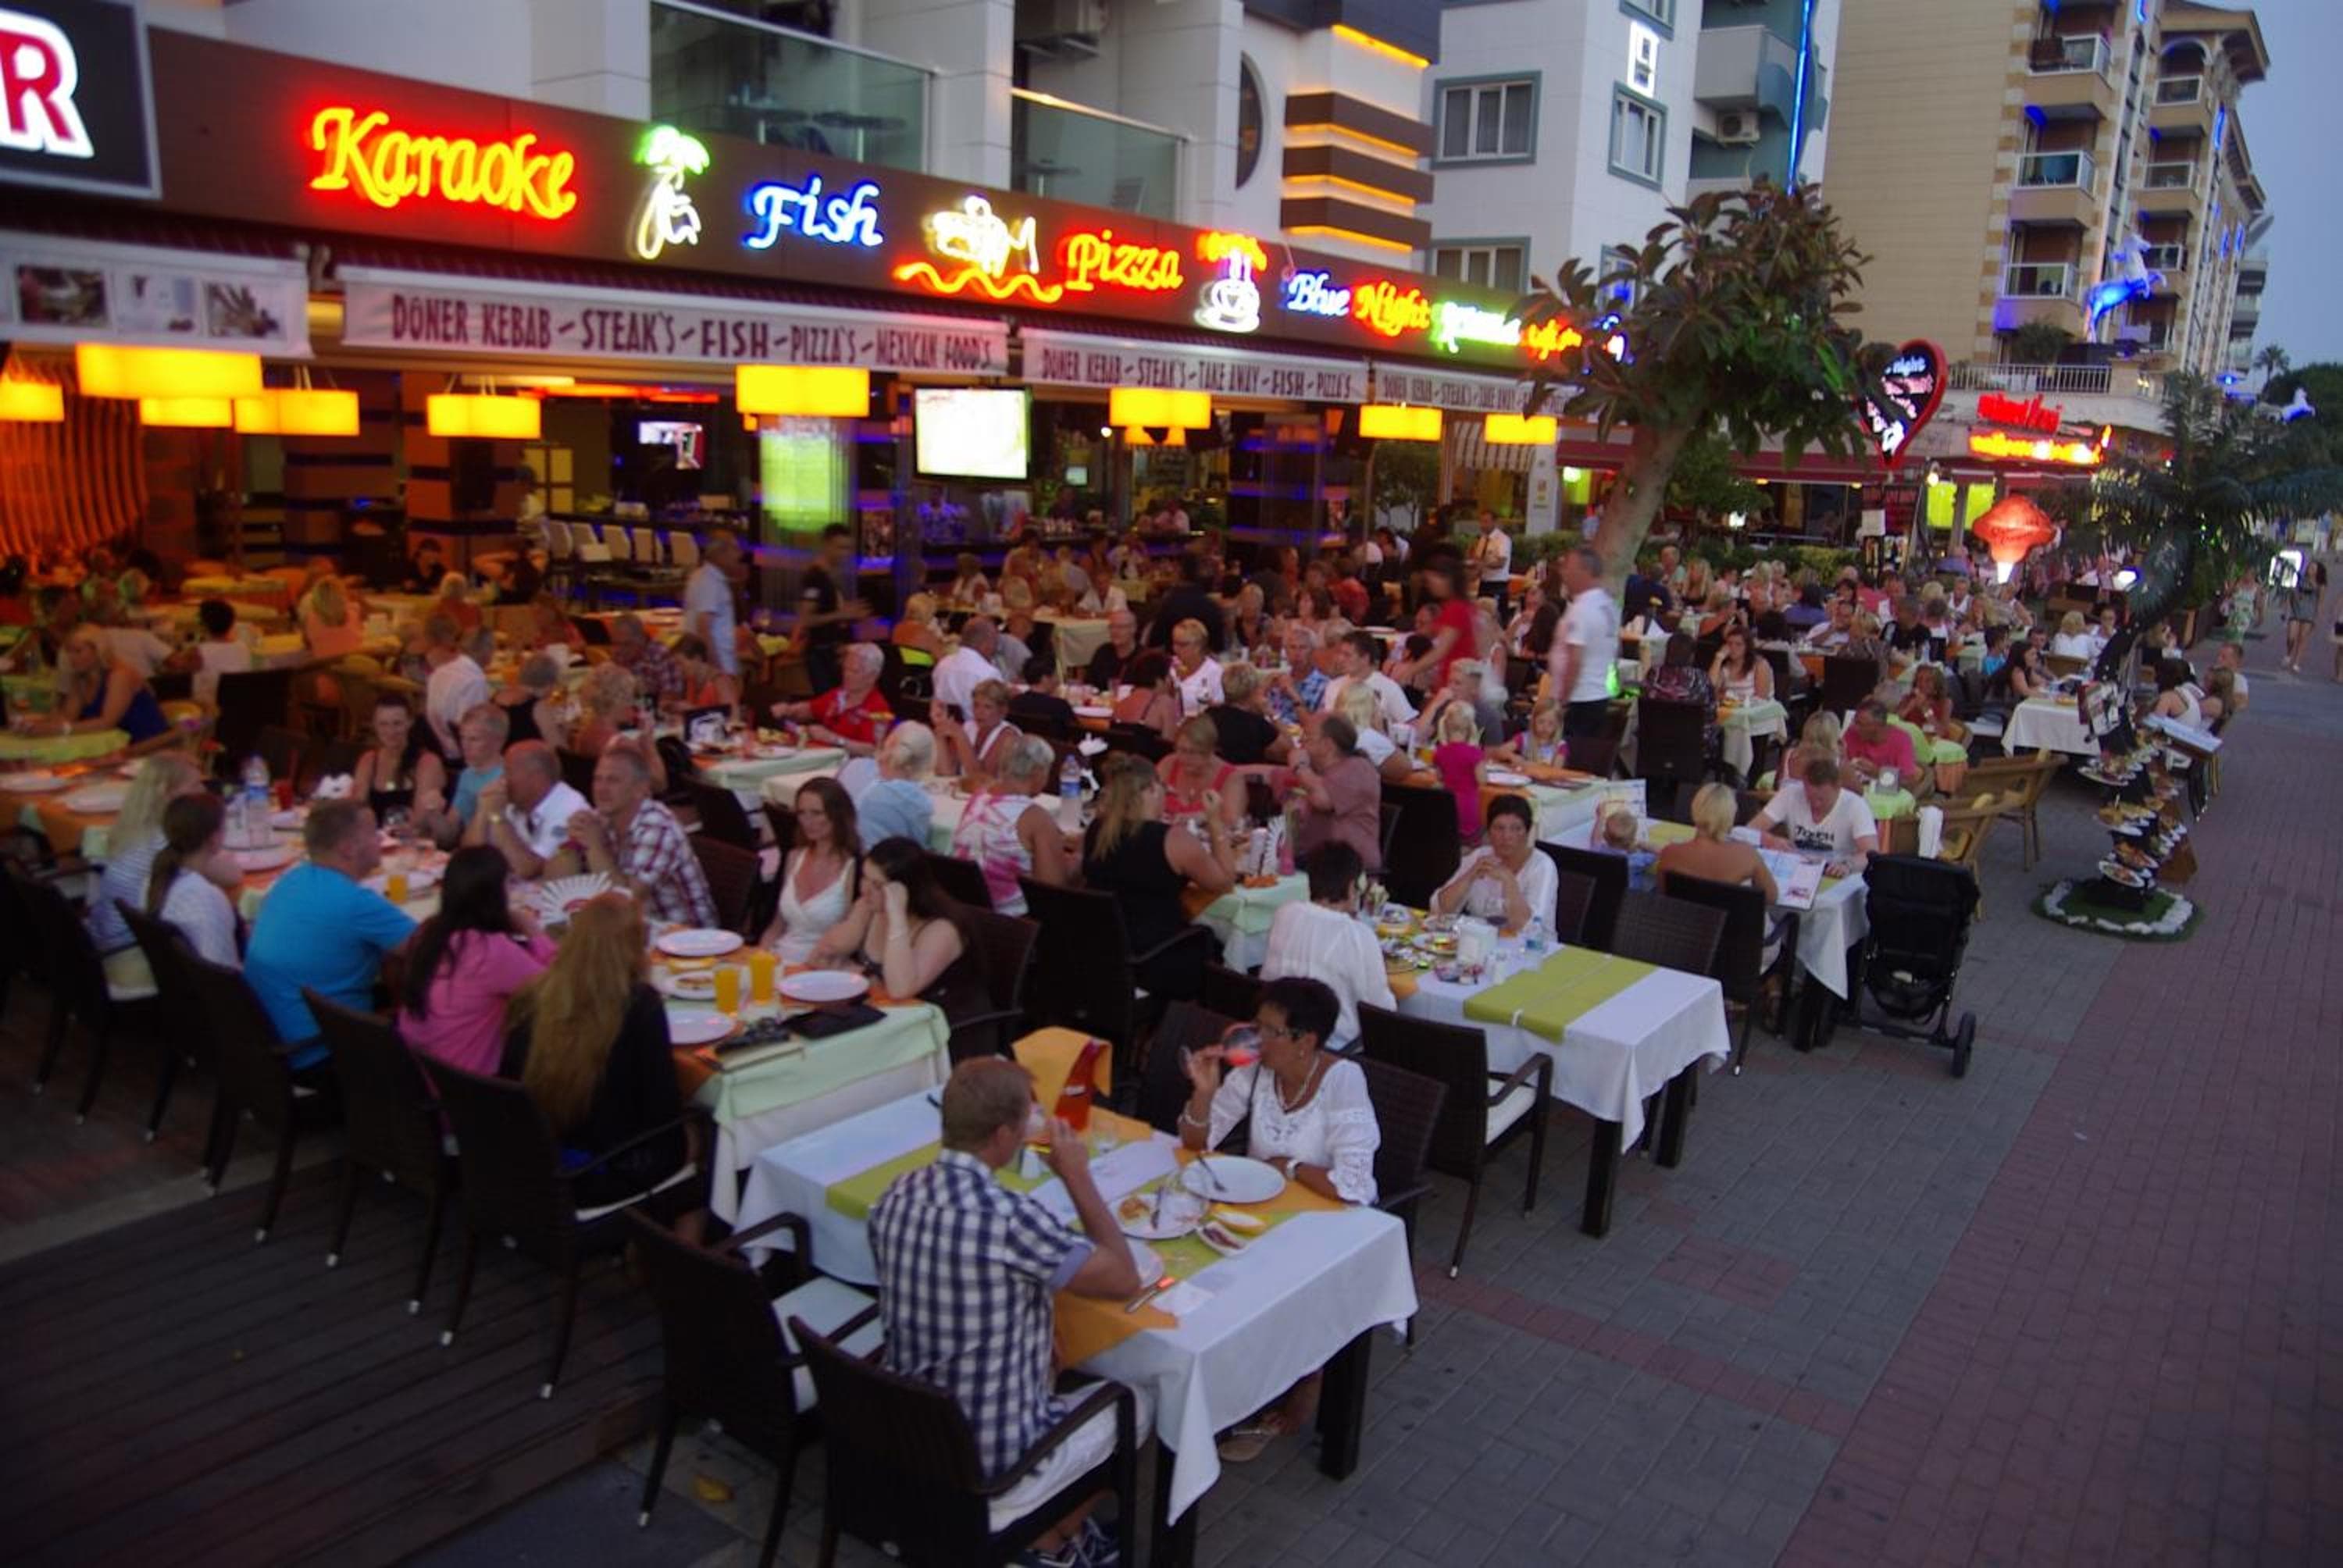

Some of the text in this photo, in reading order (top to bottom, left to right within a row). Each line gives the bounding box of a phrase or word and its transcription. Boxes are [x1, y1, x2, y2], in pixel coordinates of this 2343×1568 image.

[311, 107, 576, 219] Karaoke
[747, 175, 883, 249] Fish
[1067, 230, 1184, 291] Pizza
[482, 302, 551, 349] KEBAB
[701, 319, 769, 359] FISH
[876, 329, 936, 368] MEXICAN
[1288, 270, 1350, 316] Blue
[1355, 280, 1431, 337] Night
[1271, 369, 1305, 396] FISH
